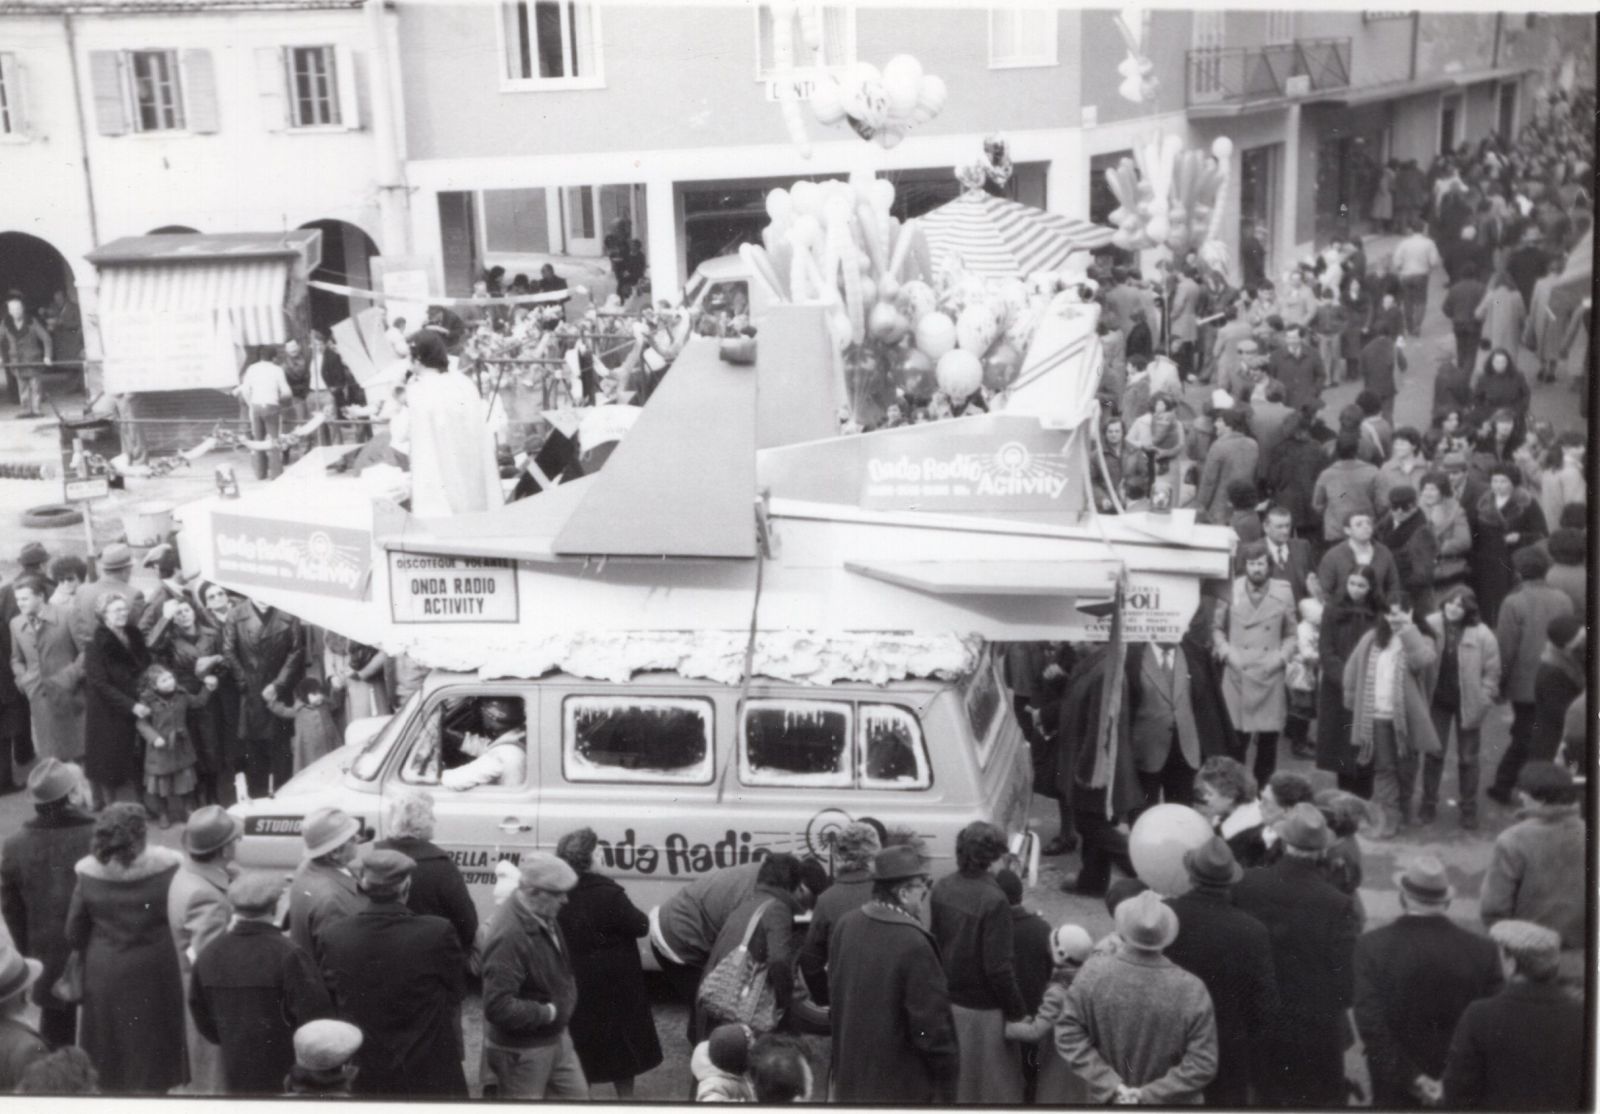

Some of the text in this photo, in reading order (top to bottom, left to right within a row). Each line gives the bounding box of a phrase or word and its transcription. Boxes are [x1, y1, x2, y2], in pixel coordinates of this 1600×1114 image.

[922, 452, 982, 482] Radio
[976, 470, 1070, 499] Activity
[296, 556, 362, 591] Activity
[411, 577, 497, 595] ONDA RADIO
[424, 597, 485, 615] ACTIVITY
[597, 828, 659, 875] nda
